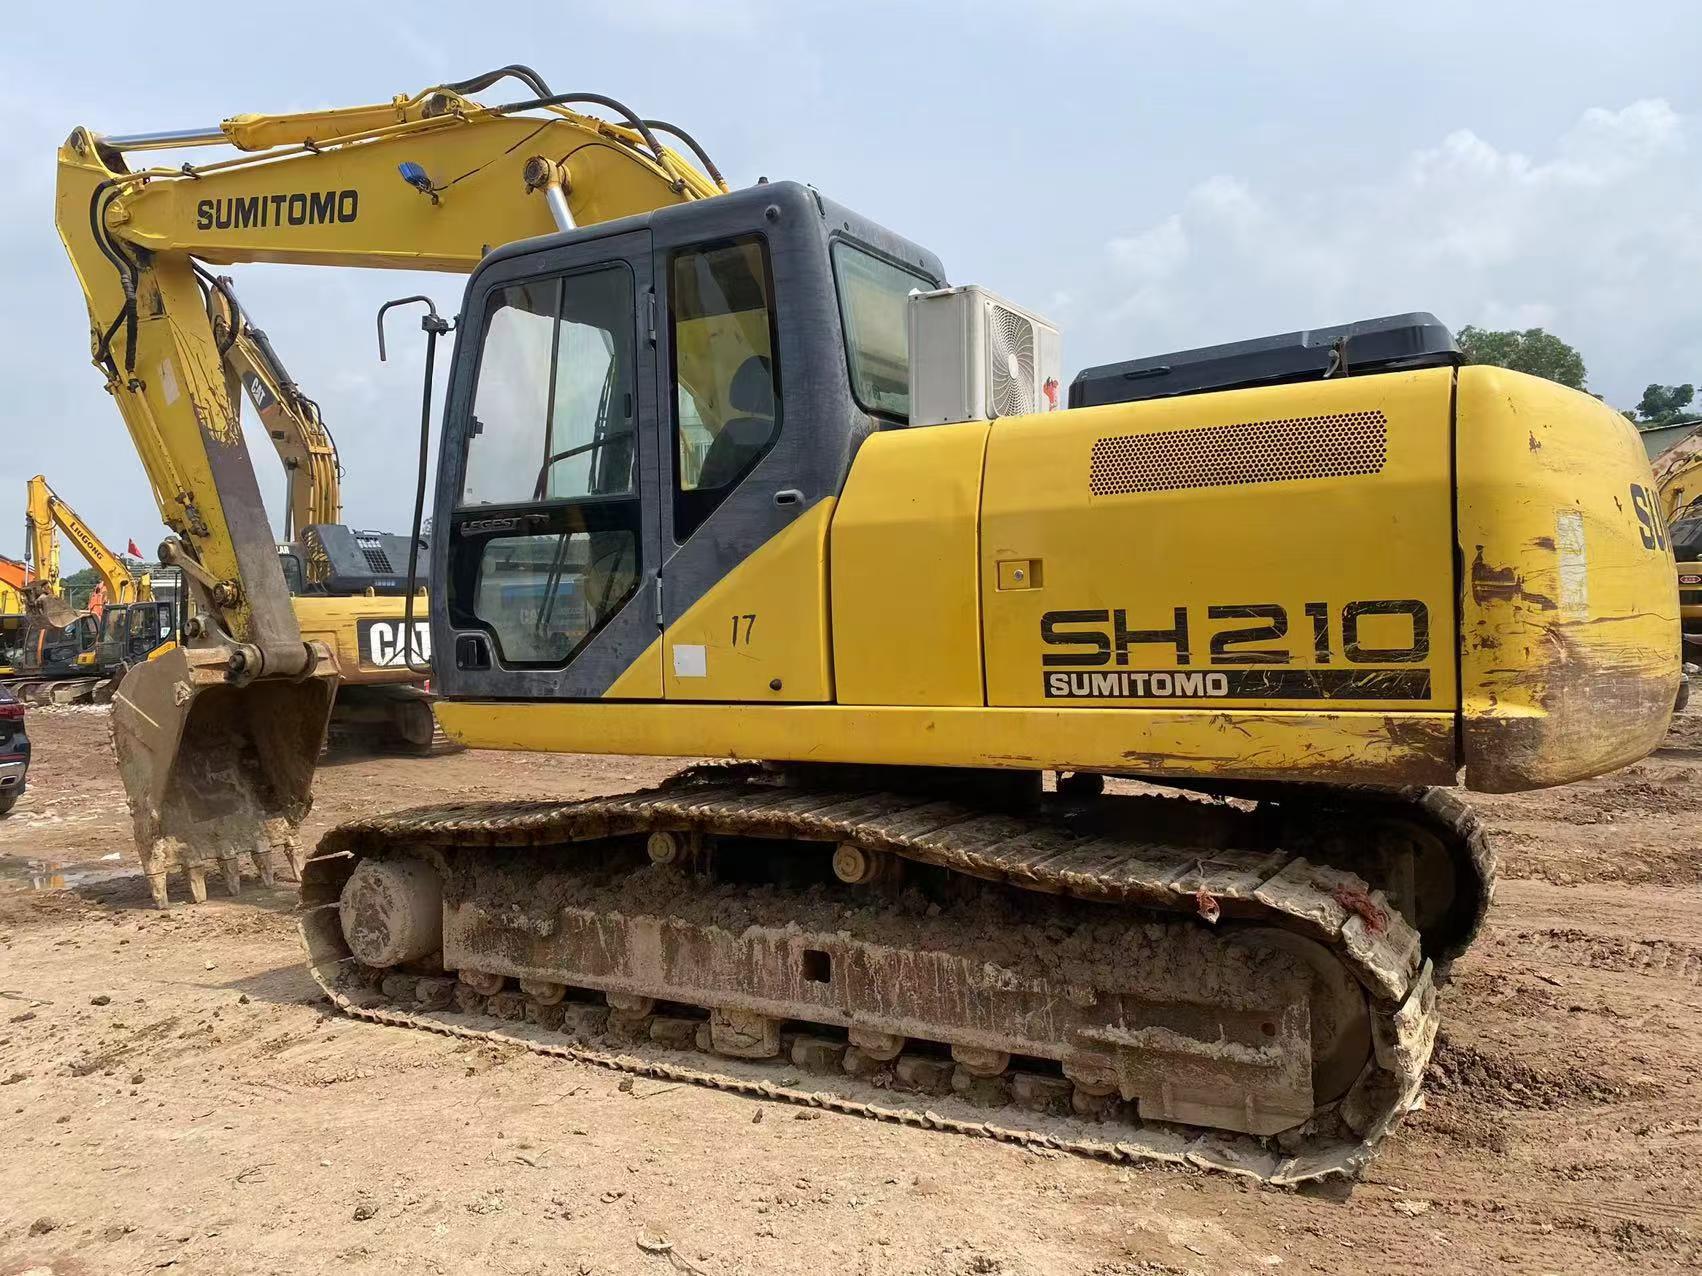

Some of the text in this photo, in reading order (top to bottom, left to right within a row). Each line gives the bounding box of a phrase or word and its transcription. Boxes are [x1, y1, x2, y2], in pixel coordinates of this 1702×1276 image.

[197, 189, 358, 230] SUMITOMO
[251, 377, 265, 406] CAT
[732, 614, 756, 647] 17
[1050, 672, 1228, 696] SUMITOMO
